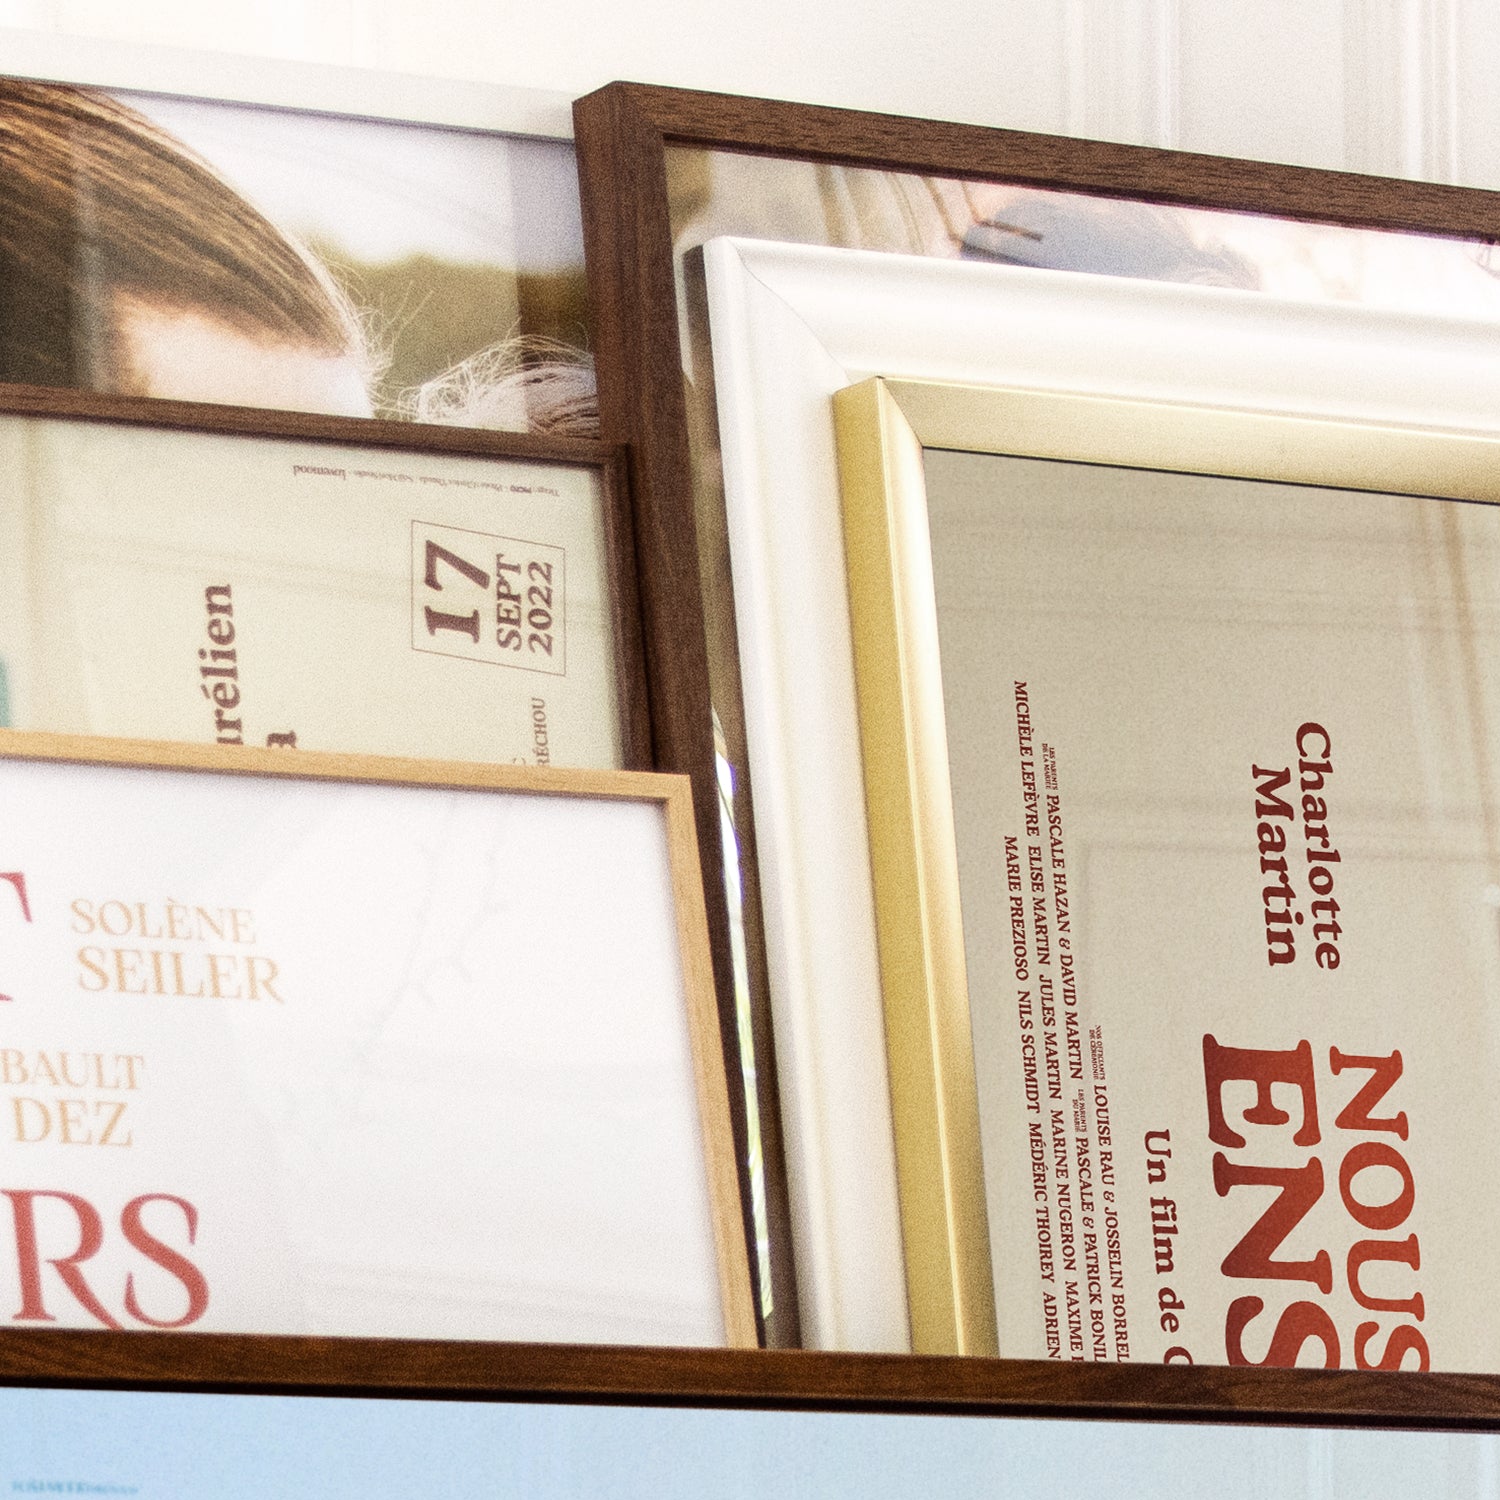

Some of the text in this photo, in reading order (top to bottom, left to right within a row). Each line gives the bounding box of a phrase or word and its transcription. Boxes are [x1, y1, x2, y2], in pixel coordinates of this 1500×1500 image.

[424, 539, 490, 644] 17
[496, 553, 522, 652] SEPT
[527, 561, 553, 657] 2022
[1013, 680, 1034, 756] MICHÈLE
[1020, 760, 1040, 836] LEFÈVRE
[1027, 845, 1044, 892] ELISE
[1252, 763, 1304, 966] Martin
[1296, 722, 1342, 970] Charlotte
[70, 897, 257, 944] SOLÈNE
[1032, 896, 1050, 965] MARTIN
[1046, 794, 1083, 1079] PASCALE HAZAN & DAVID MARTIN
[77, 945, 285, 1003] SEILER
[1038, 973, 1055, 1026] JULES
[1004, 835, 1061, 1359] MARIE PREZIOSO NILS SCHMIDT MÉDÉRIC THOIREY ADRIEN
[1043, 1031, 1062, 1099] MARTIN
[13, 1097, 133, 1148] DEZ
[1050, 1109, 1068, 1178] MARINE
[1093, 1084, 1111, 1146] LOUISE
[1099, 1150, 1114, 1185] RAU
[1144, 1128, 1171, 1184] Un
[1056, 1183, 1076, 1270] NUGERON
[1102, 1190, 1114, 1202] &
[1202, 1033, 1341, 1370] ENS
[1329, 1045, 1430, 1372] NOUS
[1075, 1136, 1106, 1360] PASCALE & PATRICK BONIL
[1104, 1206, 1123, 1288] JOSSELIN
[1149, 1196, 1178, 1274] film
[1064, 1280, 1084, 1352] MAXIME
[1111, 1293, 1129, 1361] BORREL
[1157, 1286, 1185, 1333] de
